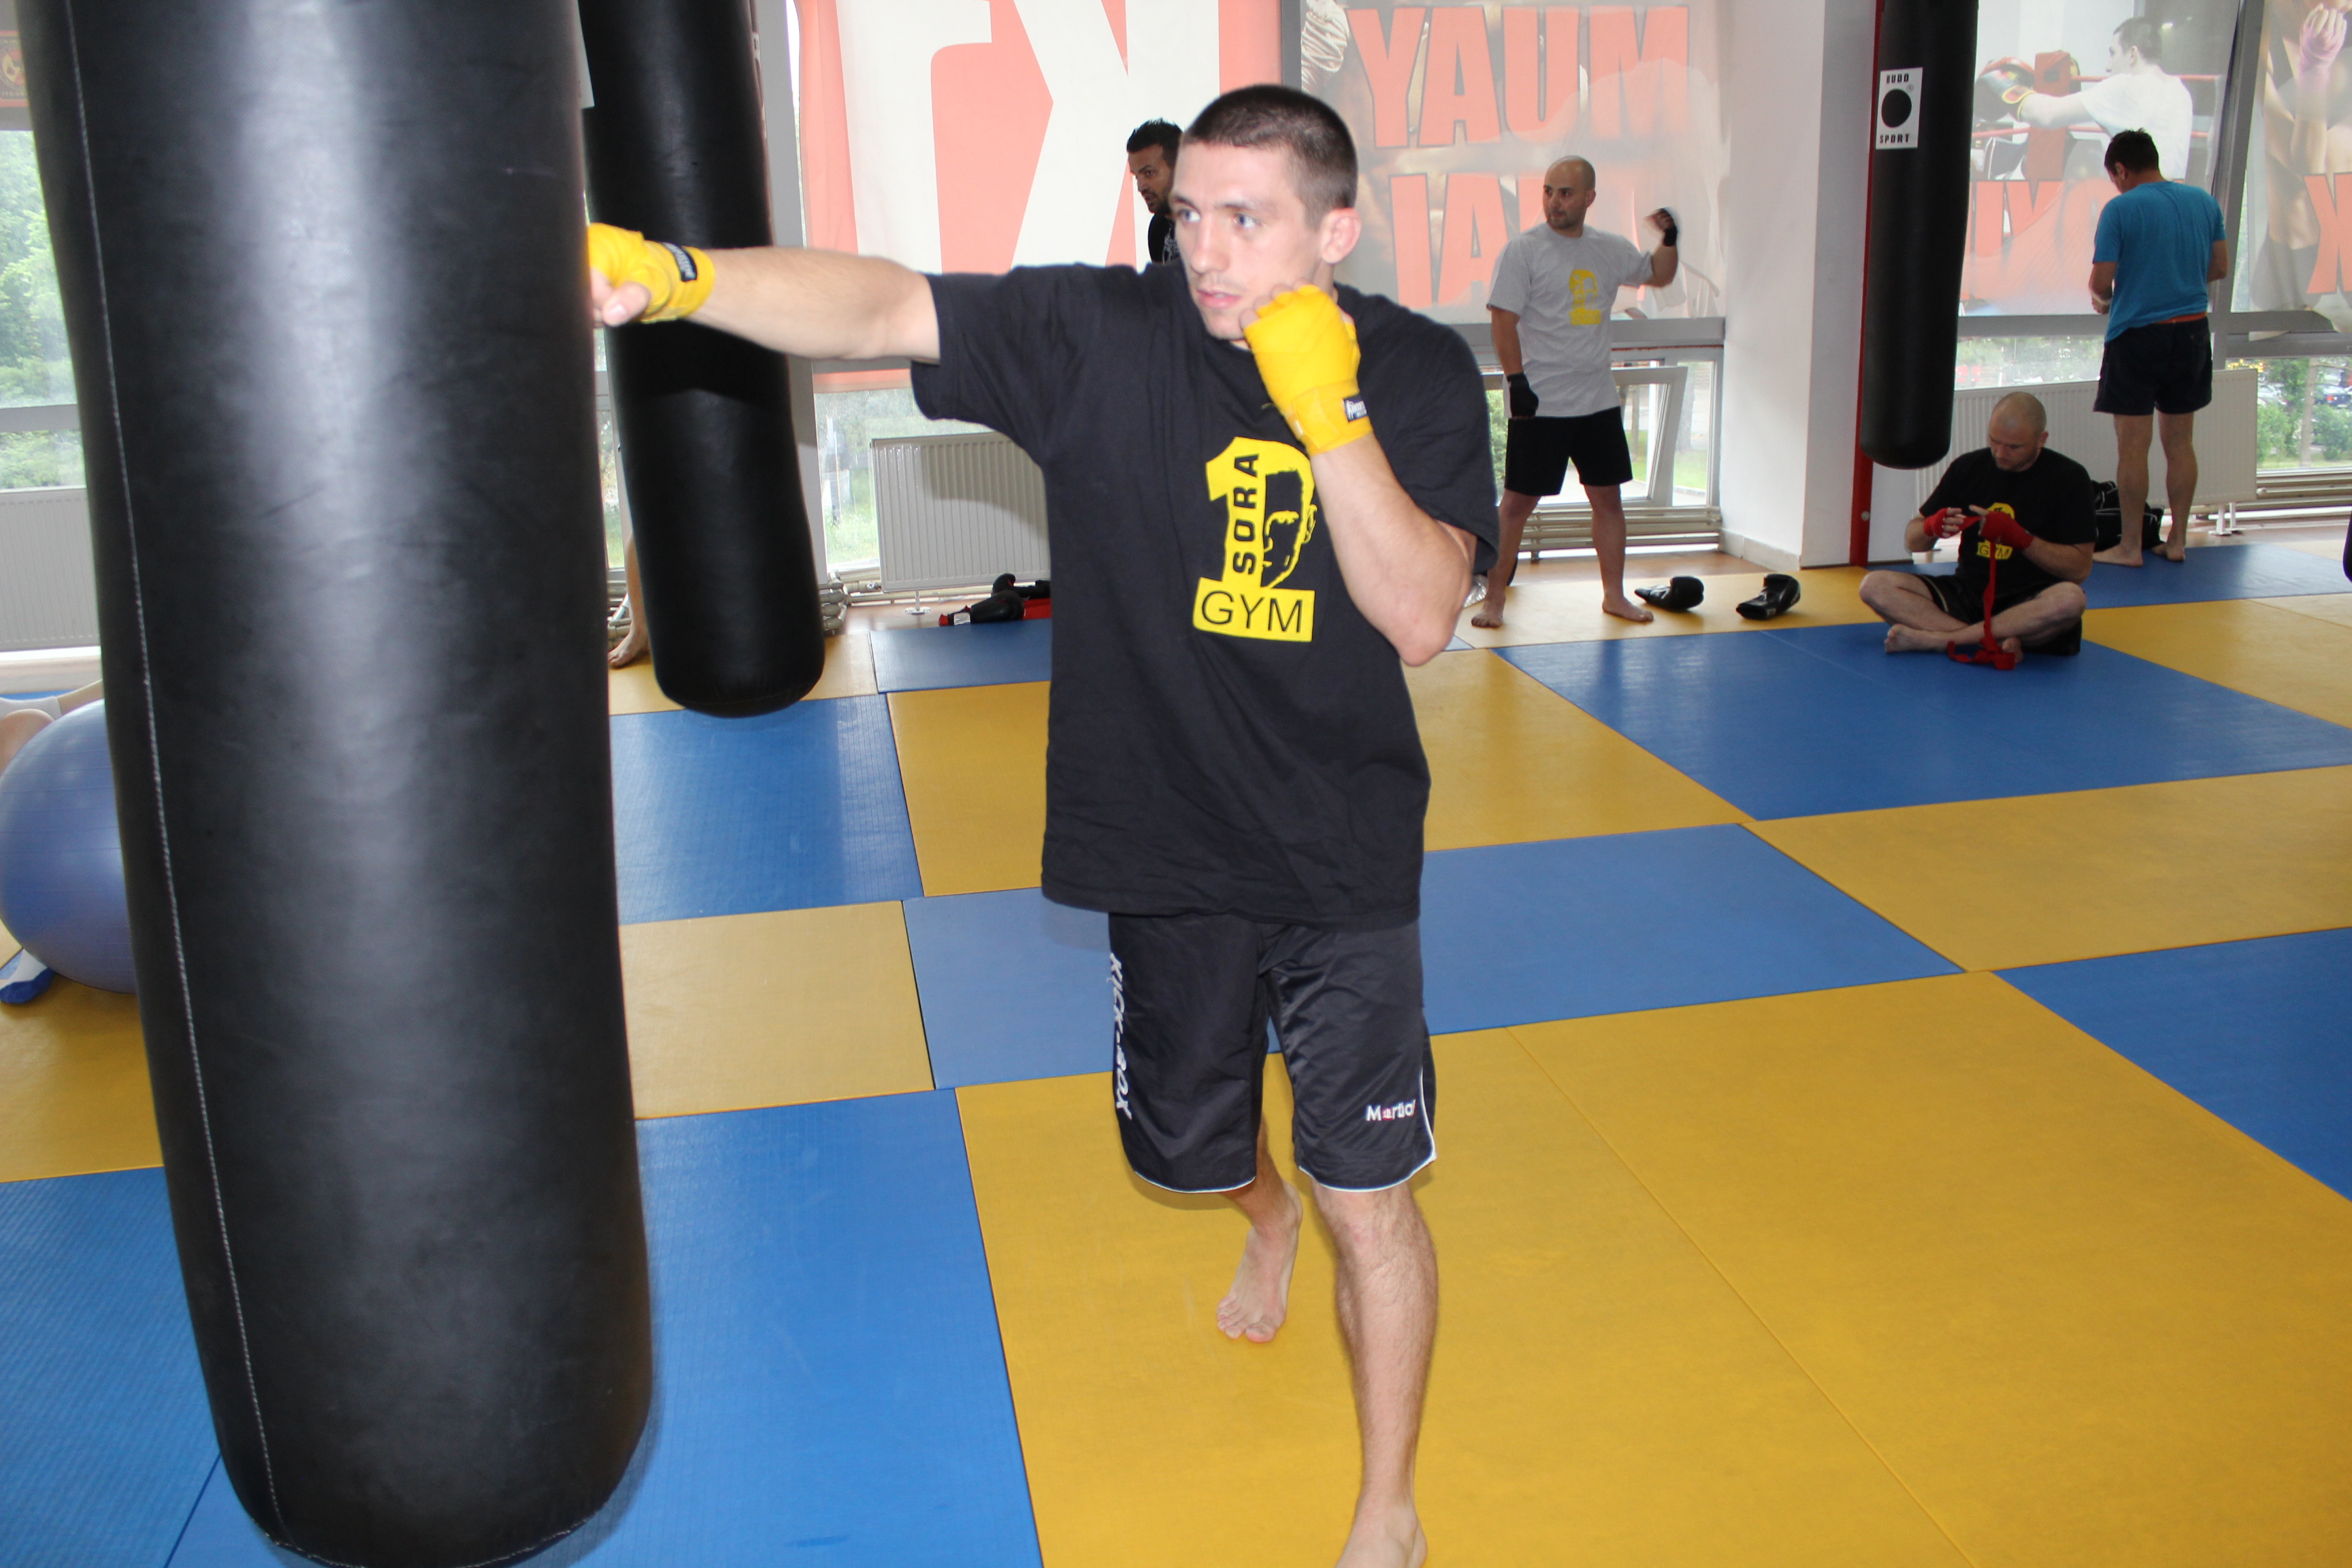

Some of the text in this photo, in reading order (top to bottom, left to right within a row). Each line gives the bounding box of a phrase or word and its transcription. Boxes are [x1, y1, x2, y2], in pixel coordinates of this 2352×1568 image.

[1886, 73, 1910, 84] BUDO
[1880, 133, 1910, 144] SPORT
[1232, 453, 1260, 575] SORA
[1979, 544, 2010, 558] GM
[1200, 590, 1304, 634] GYM
